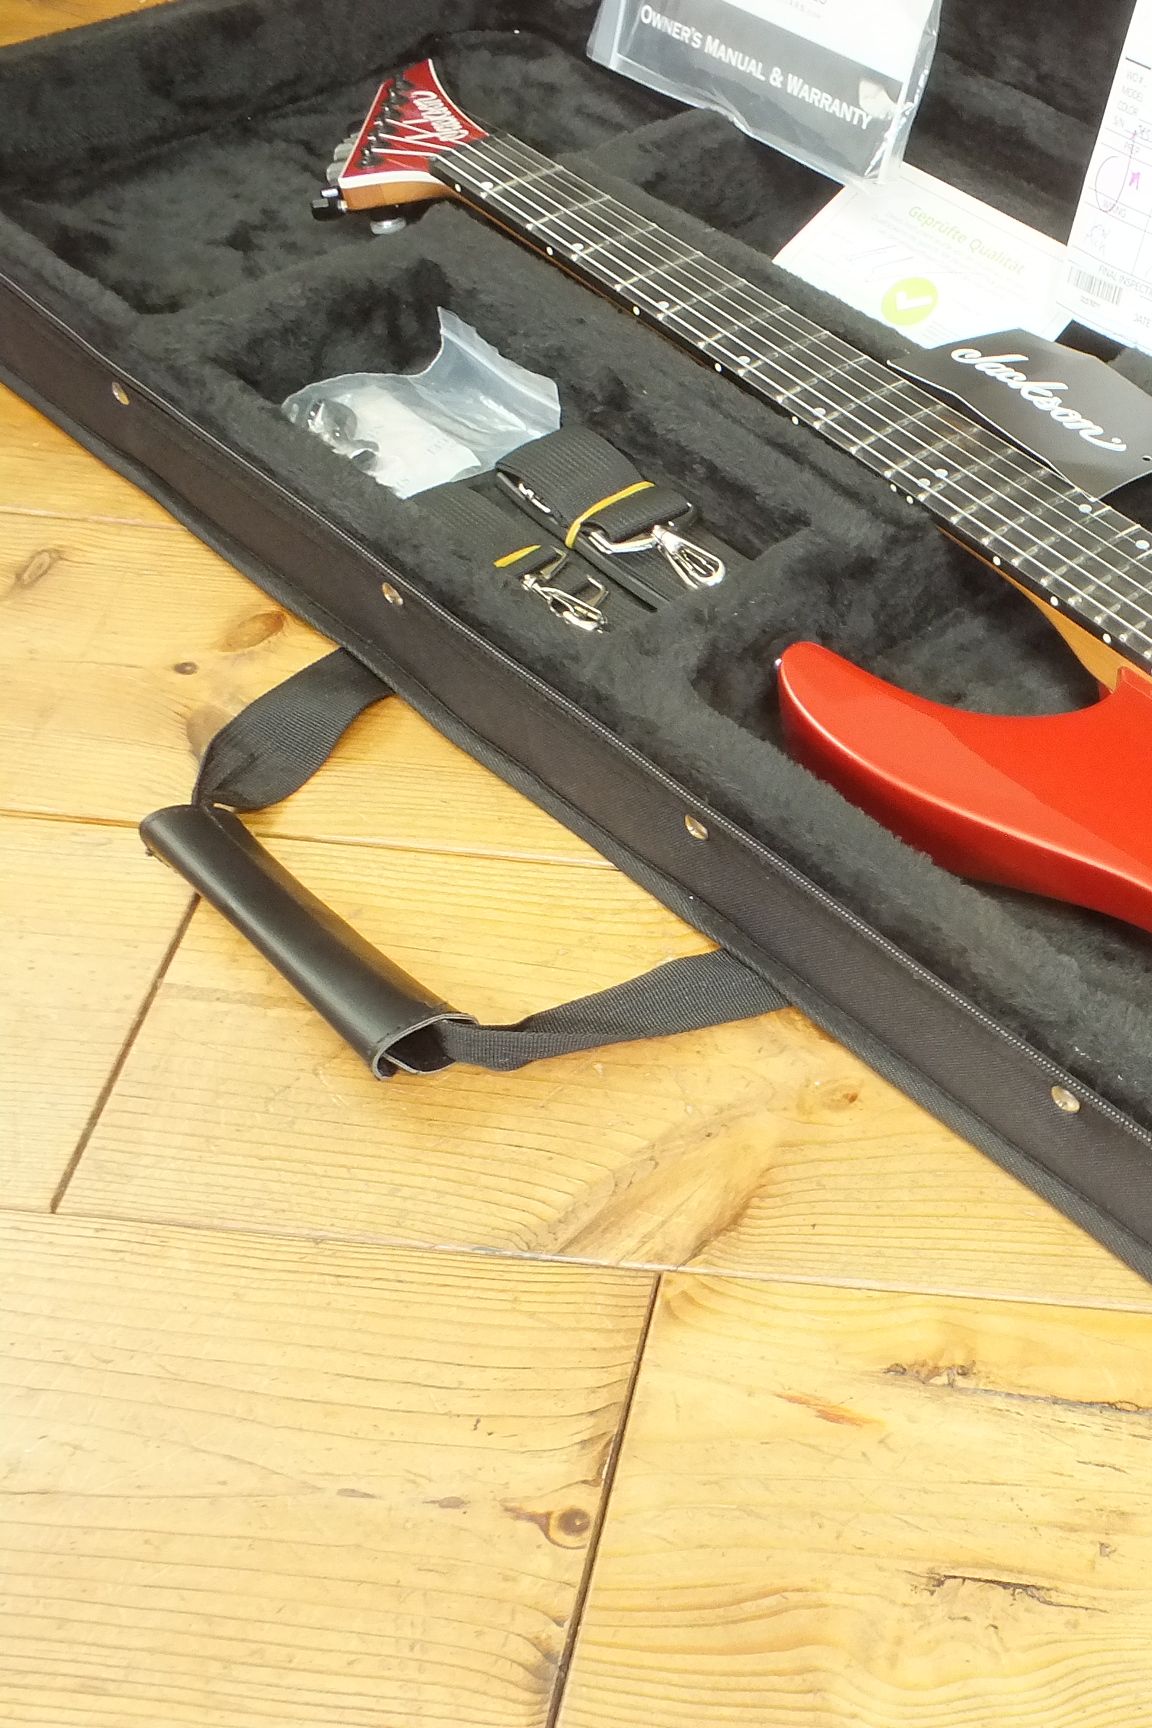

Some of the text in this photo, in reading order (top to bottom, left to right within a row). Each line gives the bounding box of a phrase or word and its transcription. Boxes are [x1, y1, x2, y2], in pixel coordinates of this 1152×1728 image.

[704, 35, 767, 83] MANUAL
[769, 67, 784, 89] &
[786, 73, 874, 130] WARRANTY
[951, 348, 1127, 452] Jackson
